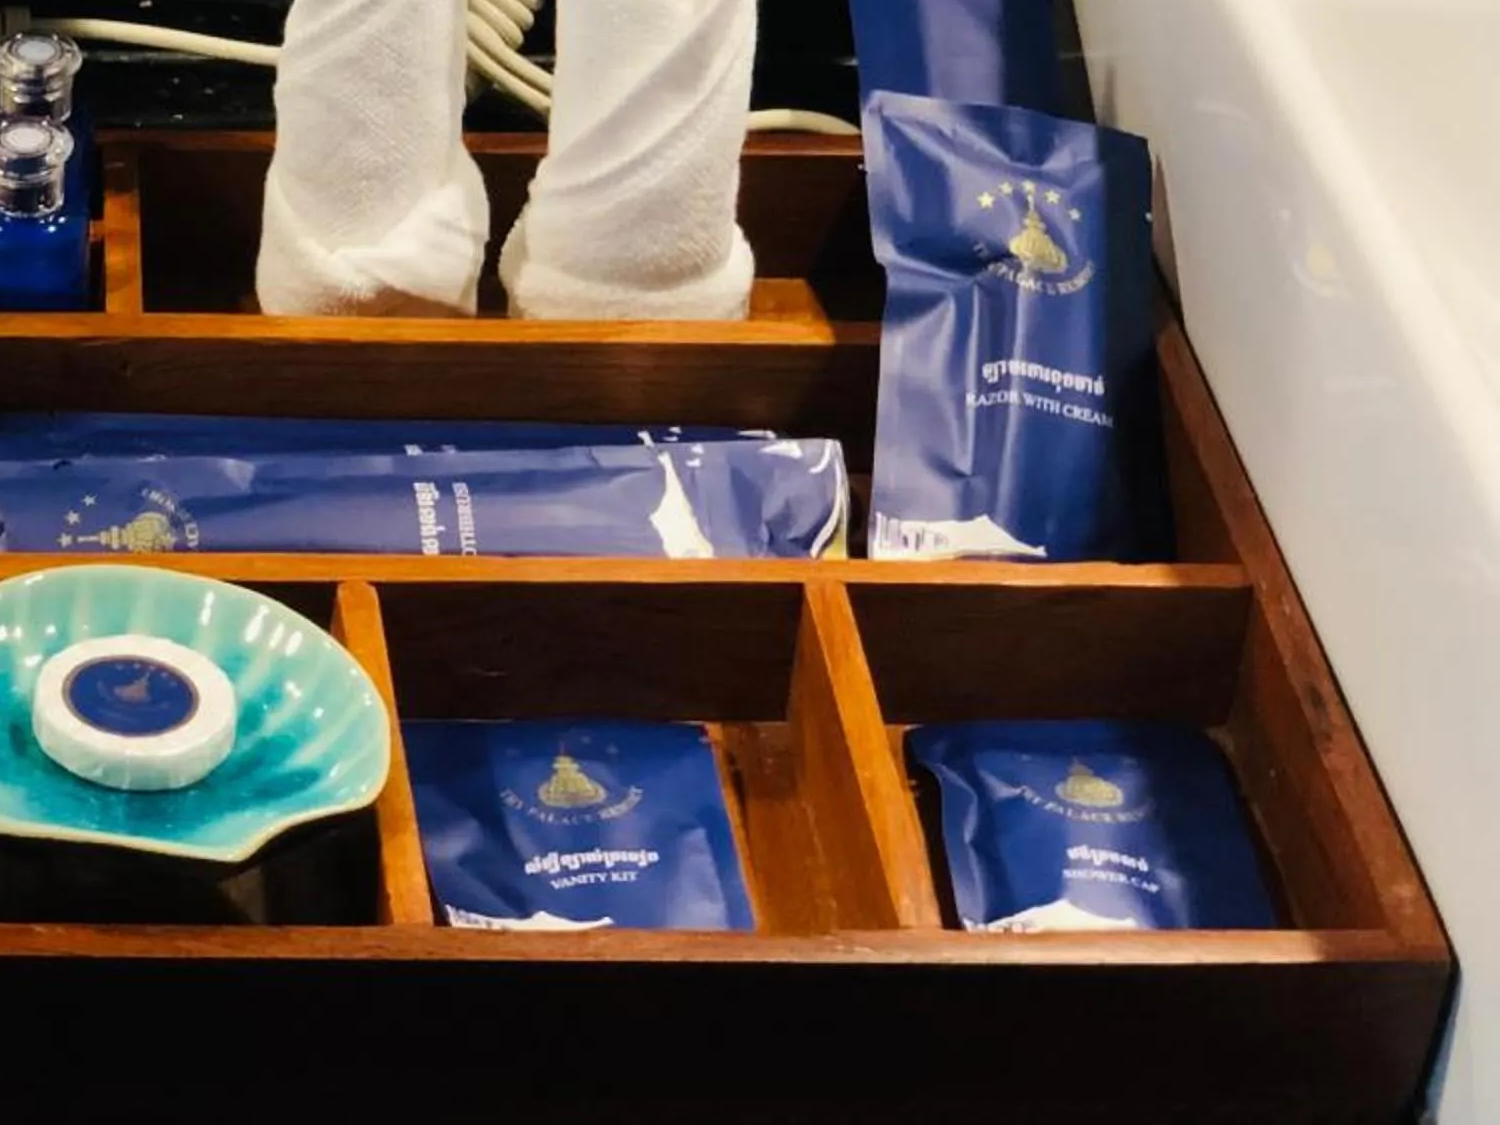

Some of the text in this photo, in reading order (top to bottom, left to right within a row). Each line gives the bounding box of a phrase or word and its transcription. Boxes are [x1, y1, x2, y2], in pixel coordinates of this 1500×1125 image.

[966, 389, 1020, 407] RAZOR
[1022, 391, 1061, 416] WITH
[550, 870, 639, 890] VANITY KIT
